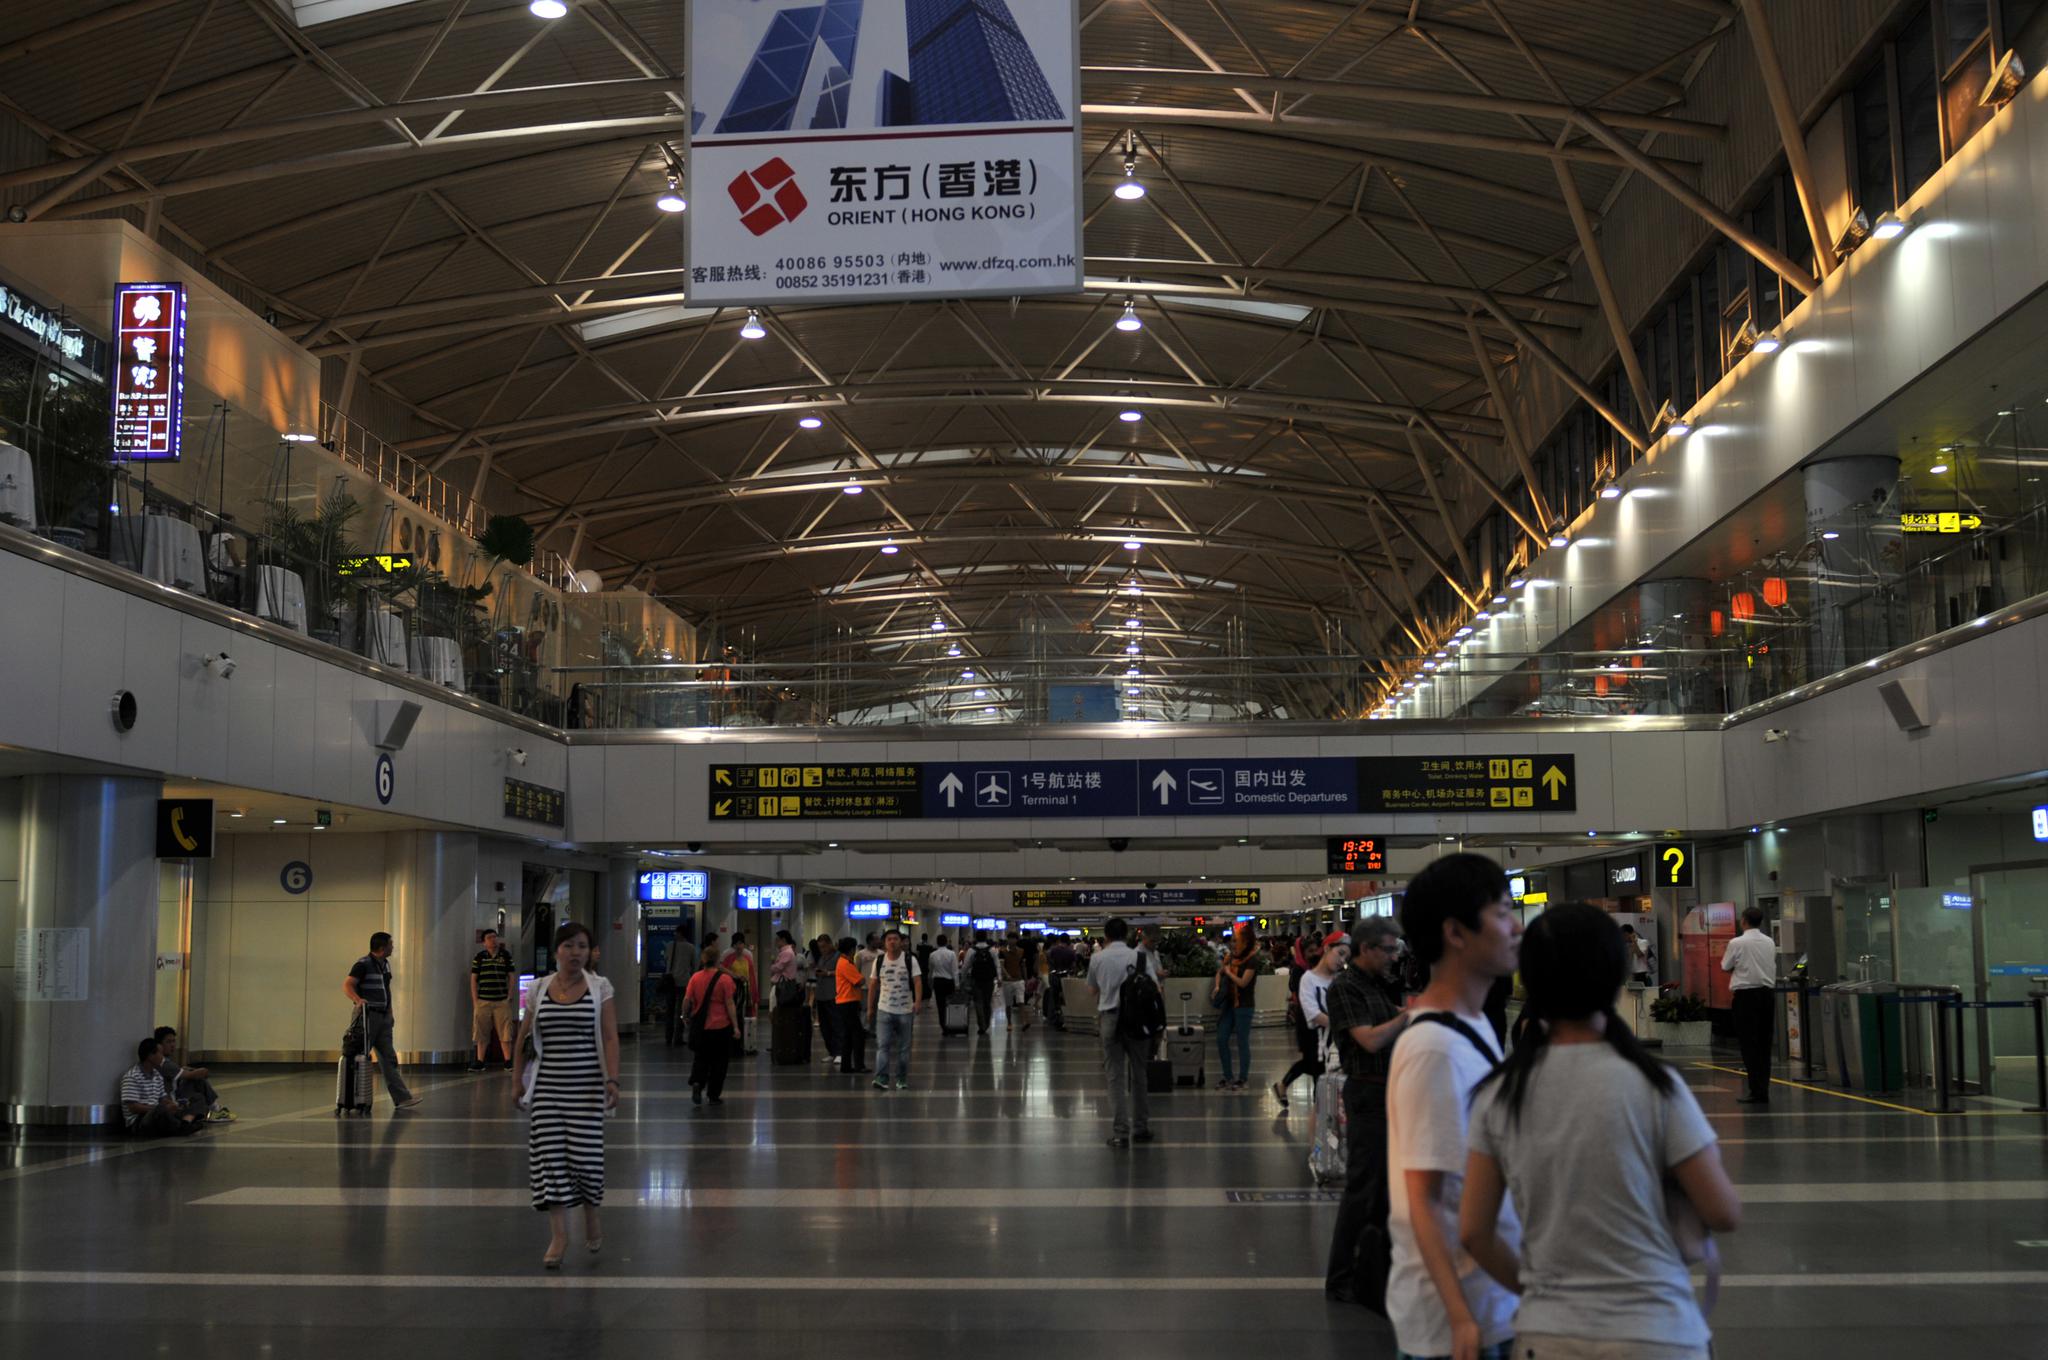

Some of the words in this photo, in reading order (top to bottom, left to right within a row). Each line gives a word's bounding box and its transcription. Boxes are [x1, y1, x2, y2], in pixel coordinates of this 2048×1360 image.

[829, 159, 1037, 203] 东方(香港)
[828, 209, 897, 225] ORIENT
[901, 206, 965, 224] (HONG
[971, 202, 1035, 221] KONG)
[776, 257, 825, 270] 40086
[834, 255, 884, 268] 95503
[890, 251, 931, 266] (内地)
[939, 254, 1075, 272] www.dfzq.com.hk
[692, 264, 768, 283] 客服热线:
[776, 275, 818, 288] 00852
[822, 273, 888, 287] 35191231
[890, 269, 931, 285] (香港)
[1422, 761, 1484, 771] 卫生间、饮用水
[380, 761, 391, 797] 6
[1022, 771, 1102, 790] 1号航站楼
[1234, 769, 1307, 788] 国内出发
[1022, 795, 1068, 806] Terminal
[1072, 795, 1077, 805] 1
[1235, 792, 1286, 803] Domestic
[1288, 791, 1348, 804] Departures
[1382, 788, 1485, 799] 商务中心、机场办证服务
[1343, 841, 1374, 852] 19:29
[1346, 852, 1358, 860] 07
[1370, 852, 1382, 860] 04
[287, 867, 306, 888] 6
